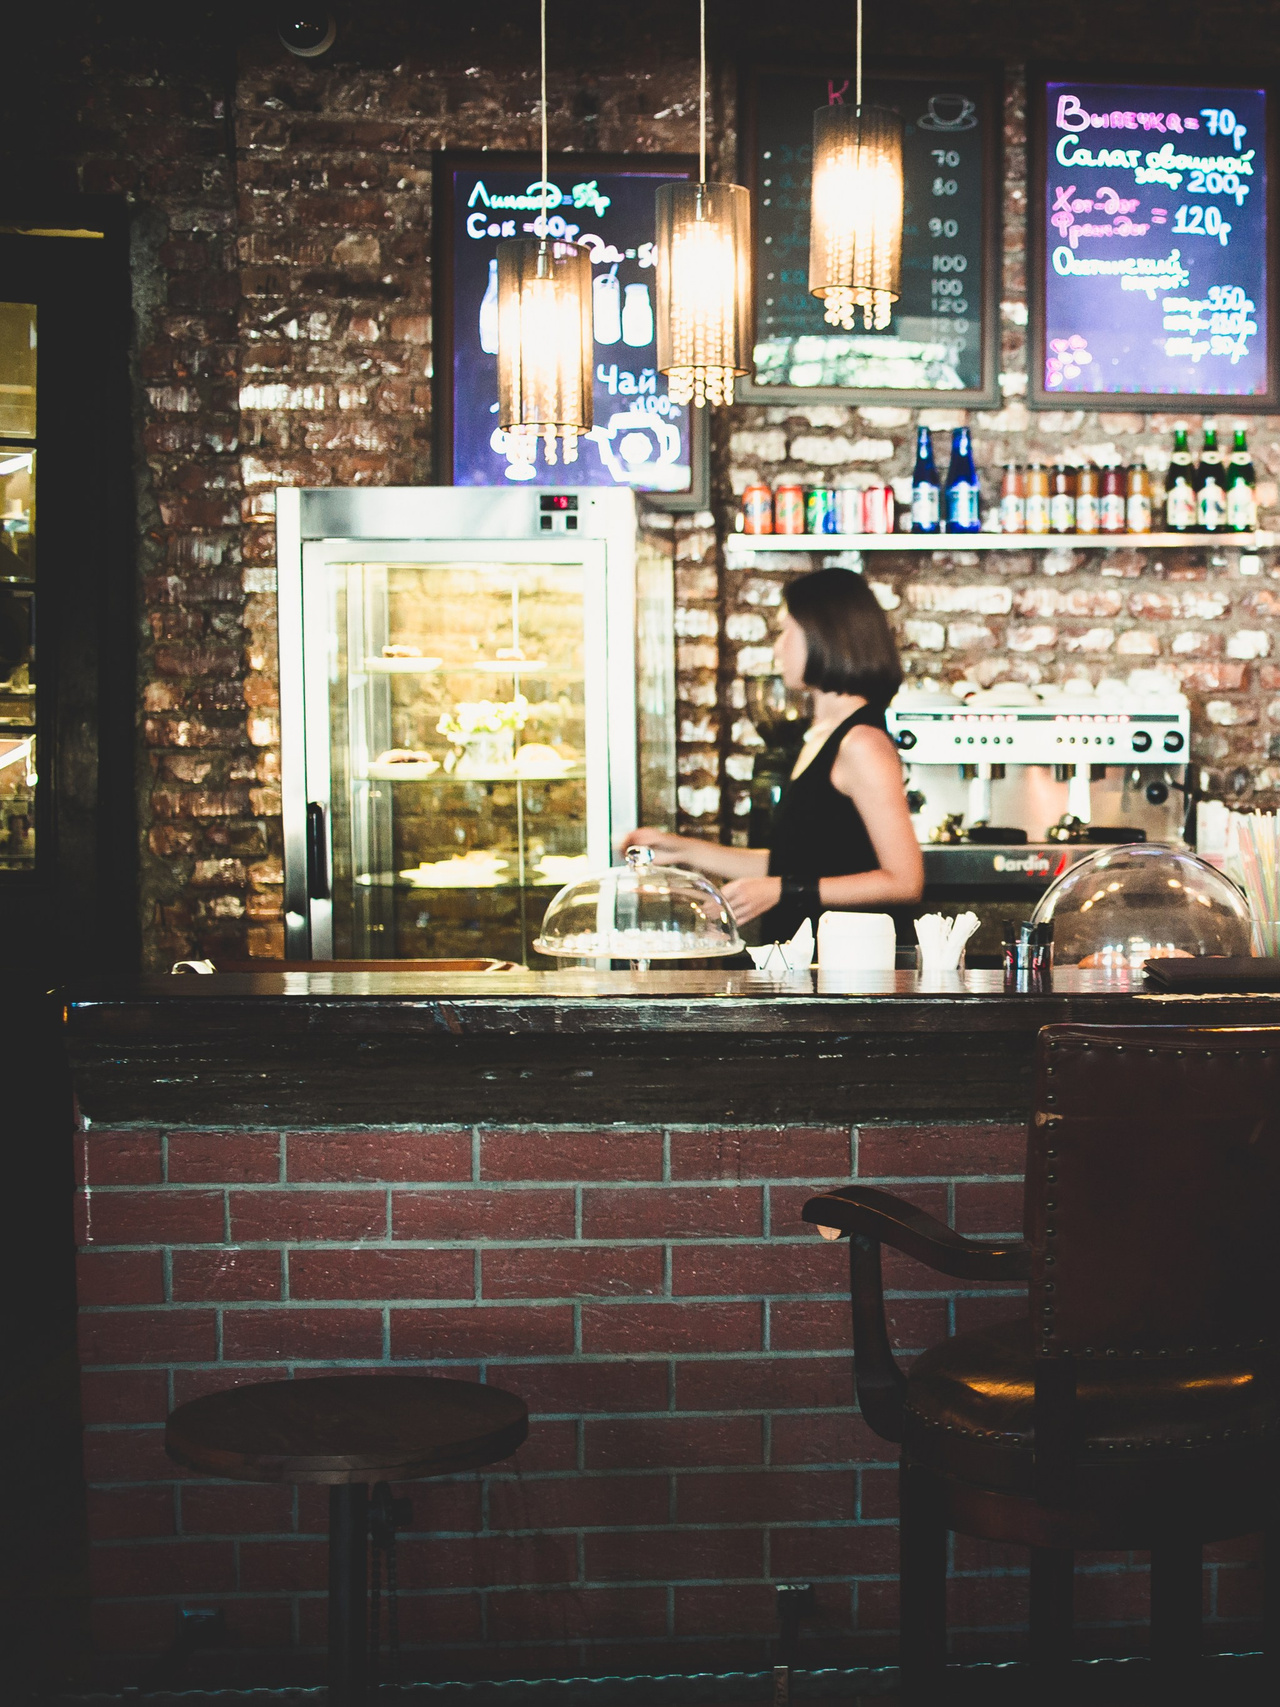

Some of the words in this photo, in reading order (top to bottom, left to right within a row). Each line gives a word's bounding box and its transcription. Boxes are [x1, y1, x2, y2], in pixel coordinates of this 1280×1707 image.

[931, 149, 960, 168] 70
[466, 212, 516, 240] Сок
[928, 216, 958, 239] 90
[932, 253, 968, 273] 100
[931, 278, 964, 298] 100
[597, 363, 657, 395] Чай
